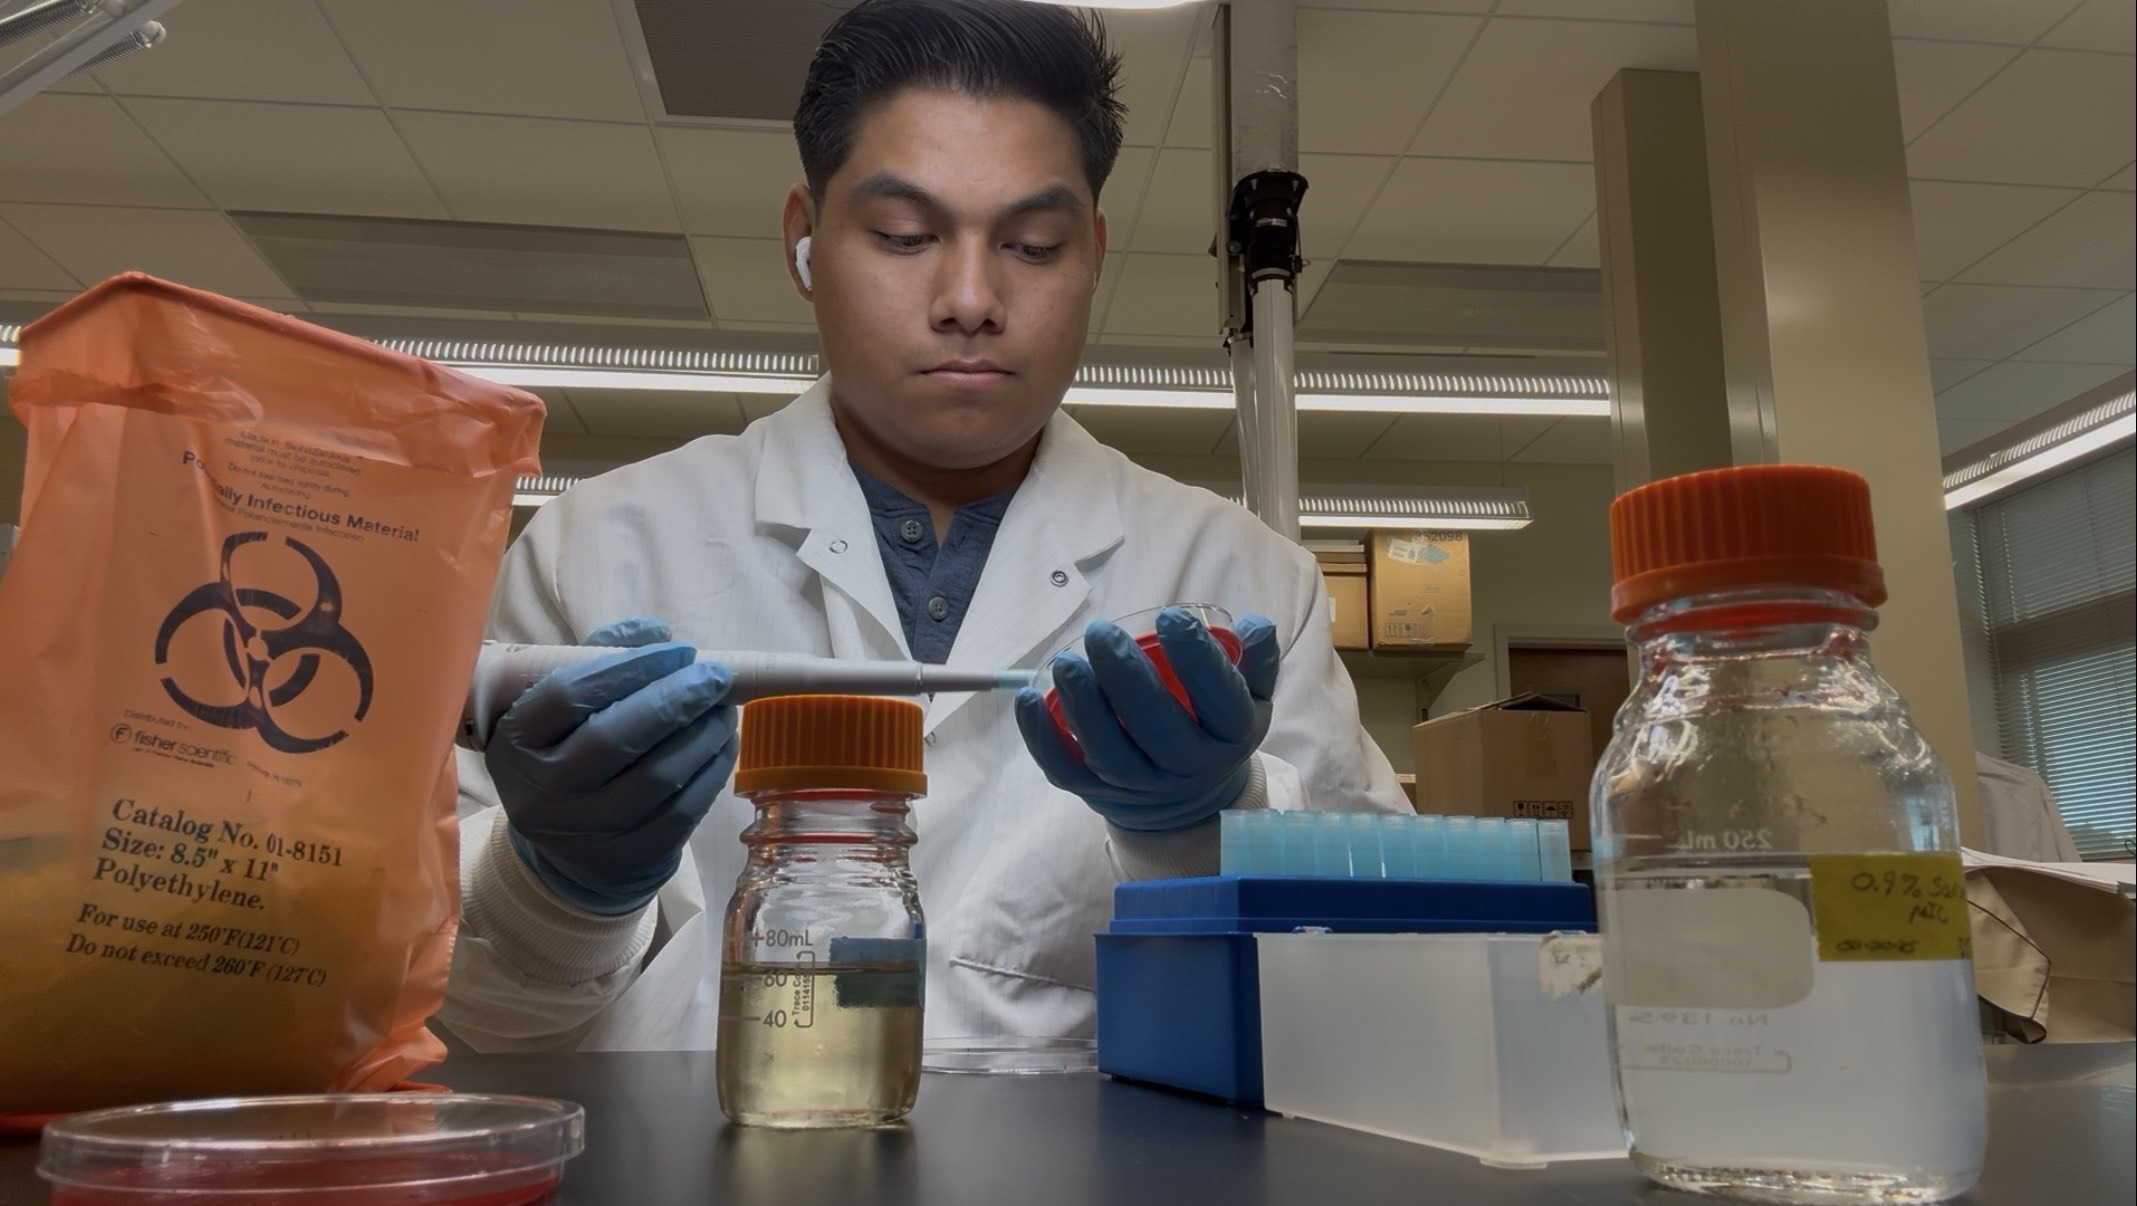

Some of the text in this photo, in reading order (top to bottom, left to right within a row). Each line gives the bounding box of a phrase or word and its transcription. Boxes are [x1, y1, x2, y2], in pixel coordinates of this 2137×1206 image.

[246, 493, 341, 525] Infectious
[346, 514, 420, 543] Material
[124, 709, 175, 728] Distributed
[134, 730, 176, 751] fisher
[180, 742, 237, 766] scientific
[112, 798, 343, 866] Catalog No. 01-8151
[101, 827, 279, 882] Size: 8.5" x 11"
[93, 856, 266, 911] Polyethylene.
[1852, 871, 1922, 899] 0.9%
[76, 903, 117, 927] For
[121, 915, 157, 936] use
[161, 920, 182, 939] at
[65, 933, 97, 956] Do
[100, 941, 138, 962] not
[141, 951, 211, 973] exceed
[791, 989, 802, 1017] Trace
